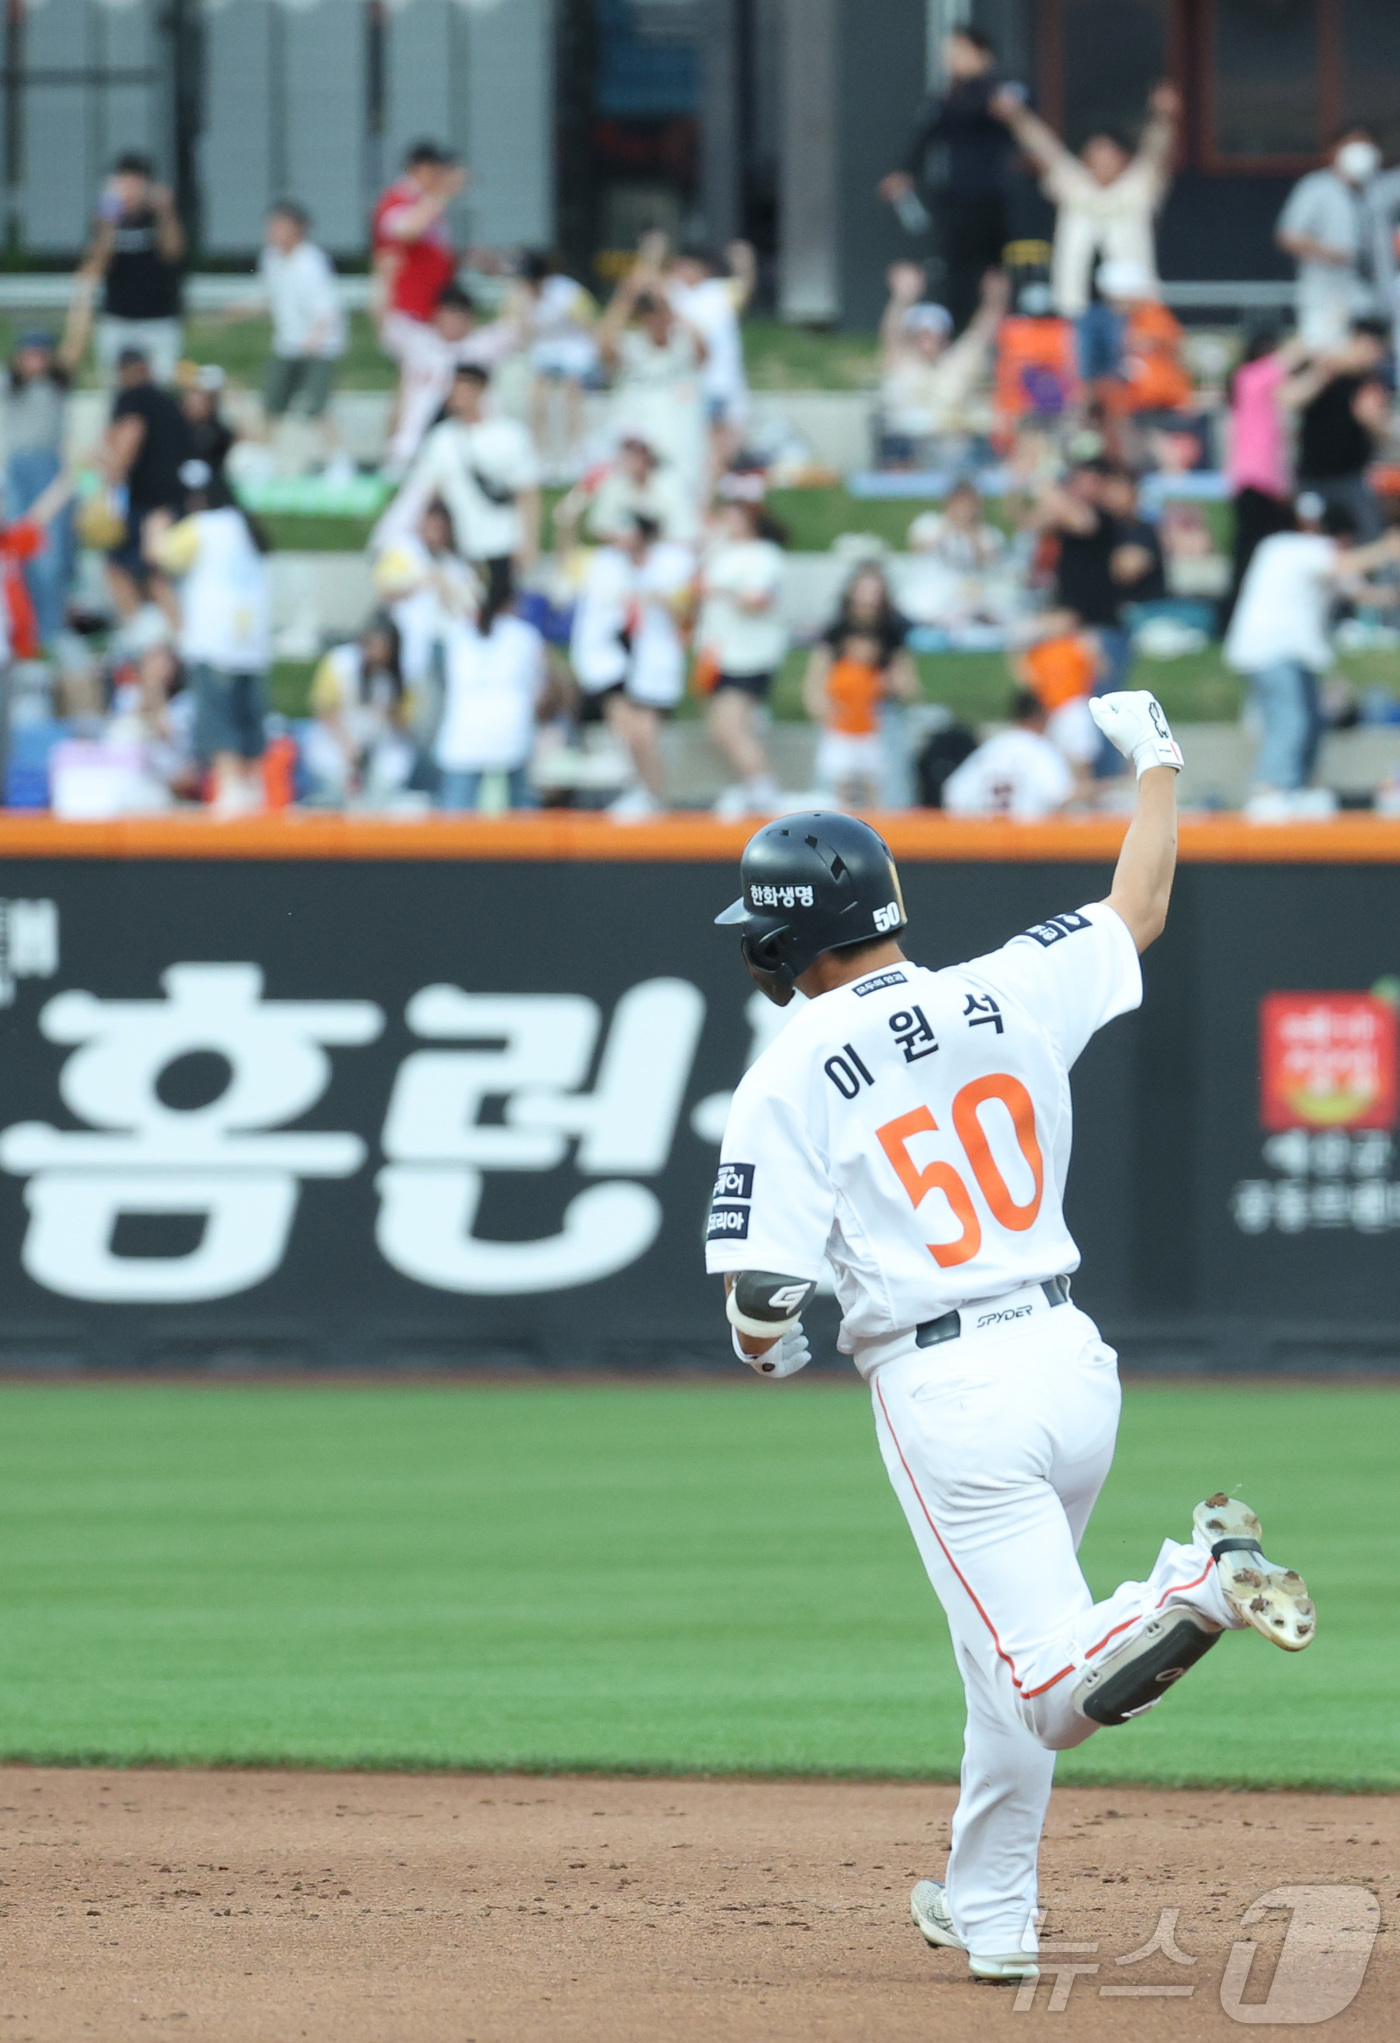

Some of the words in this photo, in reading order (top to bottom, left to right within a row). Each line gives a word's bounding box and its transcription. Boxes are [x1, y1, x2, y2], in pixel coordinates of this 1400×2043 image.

[750, 885, 814, 908] 한화생명
[872, 901, 901, 932] 50
[0, 962, 800, 1304] 홈런
[875, 1072, 1044, 1269] 50
[976, 1304, 1033, 1329] SPYDER
